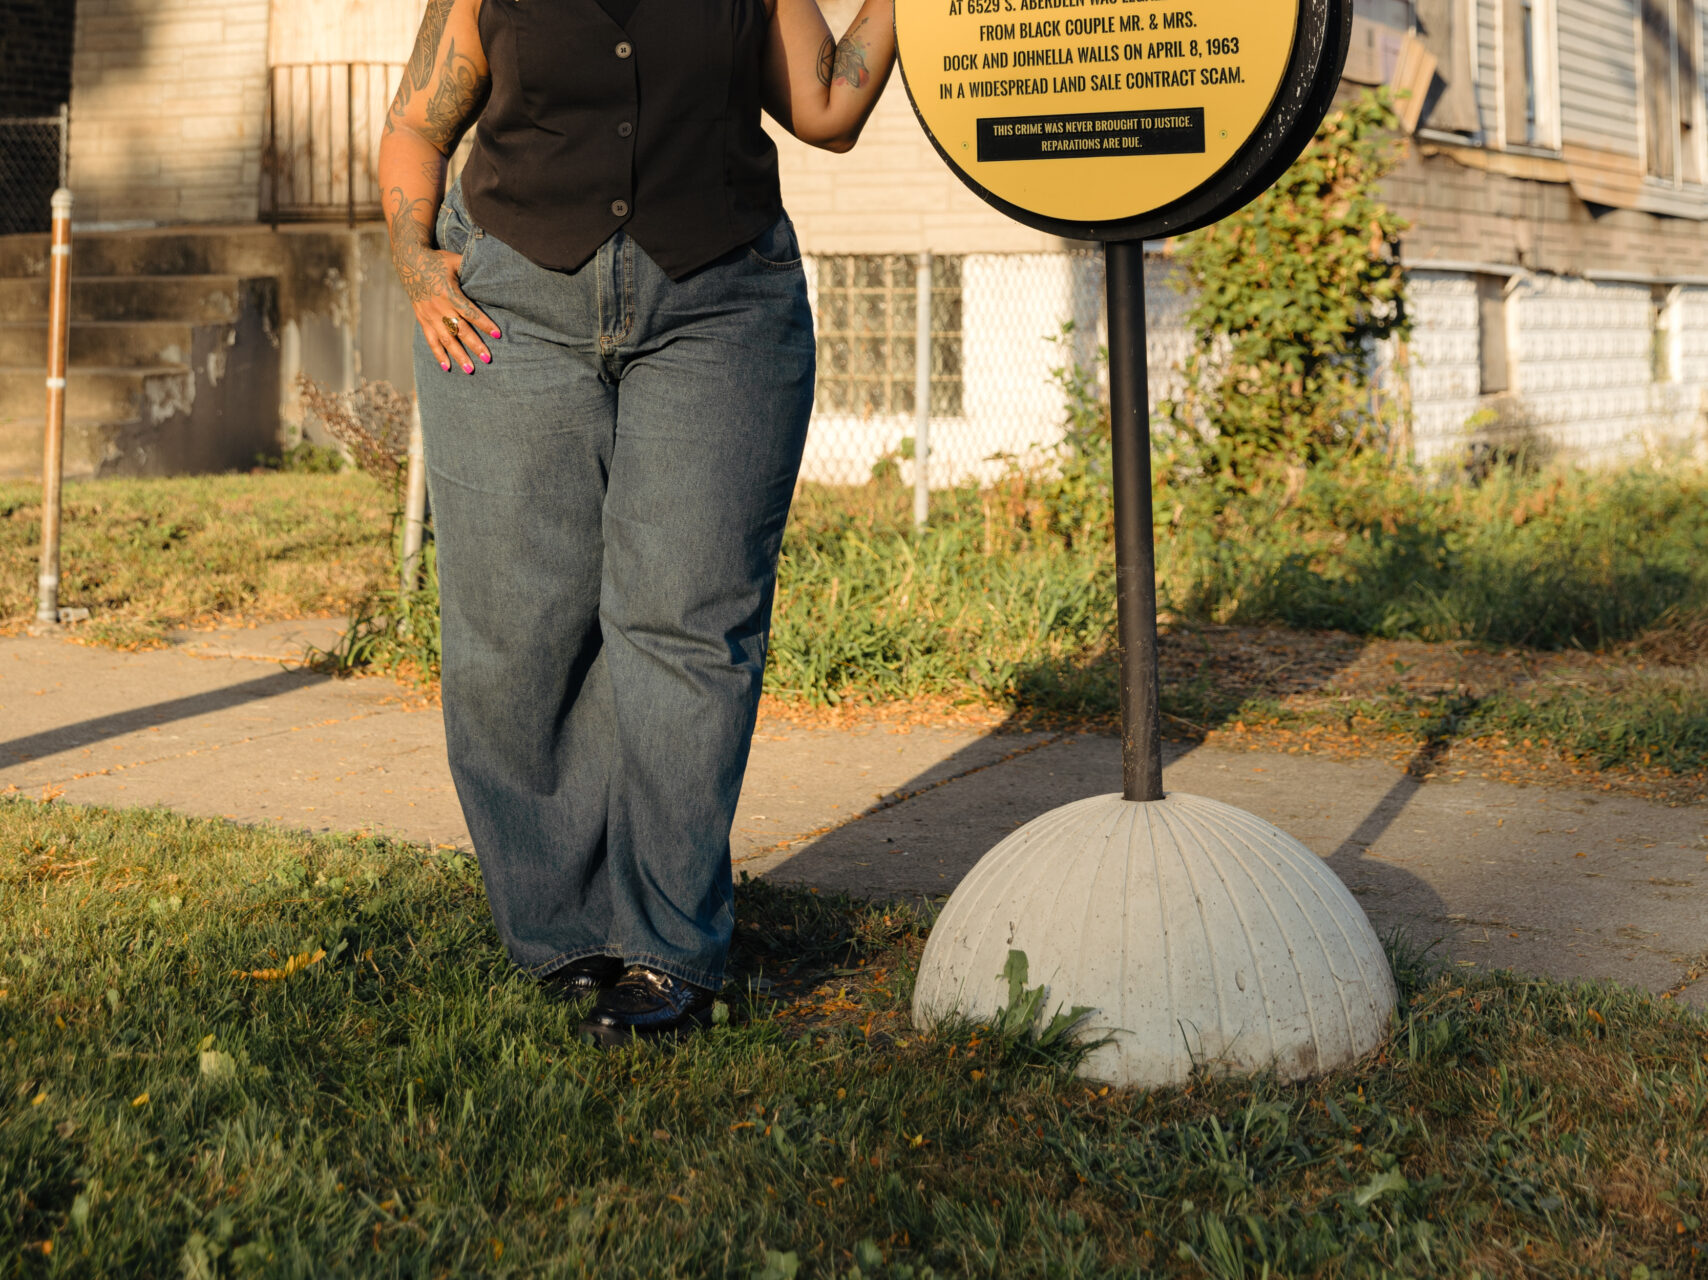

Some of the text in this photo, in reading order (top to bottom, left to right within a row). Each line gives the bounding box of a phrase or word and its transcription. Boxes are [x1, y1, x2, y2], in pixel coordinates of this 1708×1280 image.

[949, 0, 963, 16] AT
[980, 11, 1197, 41] FROM BLACK COUPLE MR. & MRS.
[944, 37, 1239, 71] DOCK AND JOHNELLA WALLS ON APRIL 8, 1963
[940, 66, 1245, 99] IN A WIDESPREAD LAND SALE CONTRACT SCAM.
[993, 116, 1193, 136] THIS CRIME WAS NEVER BROUGHT TO JUSTICE.
[1042, 137, 1142, 151] REPARATIONS ARE DUE.
